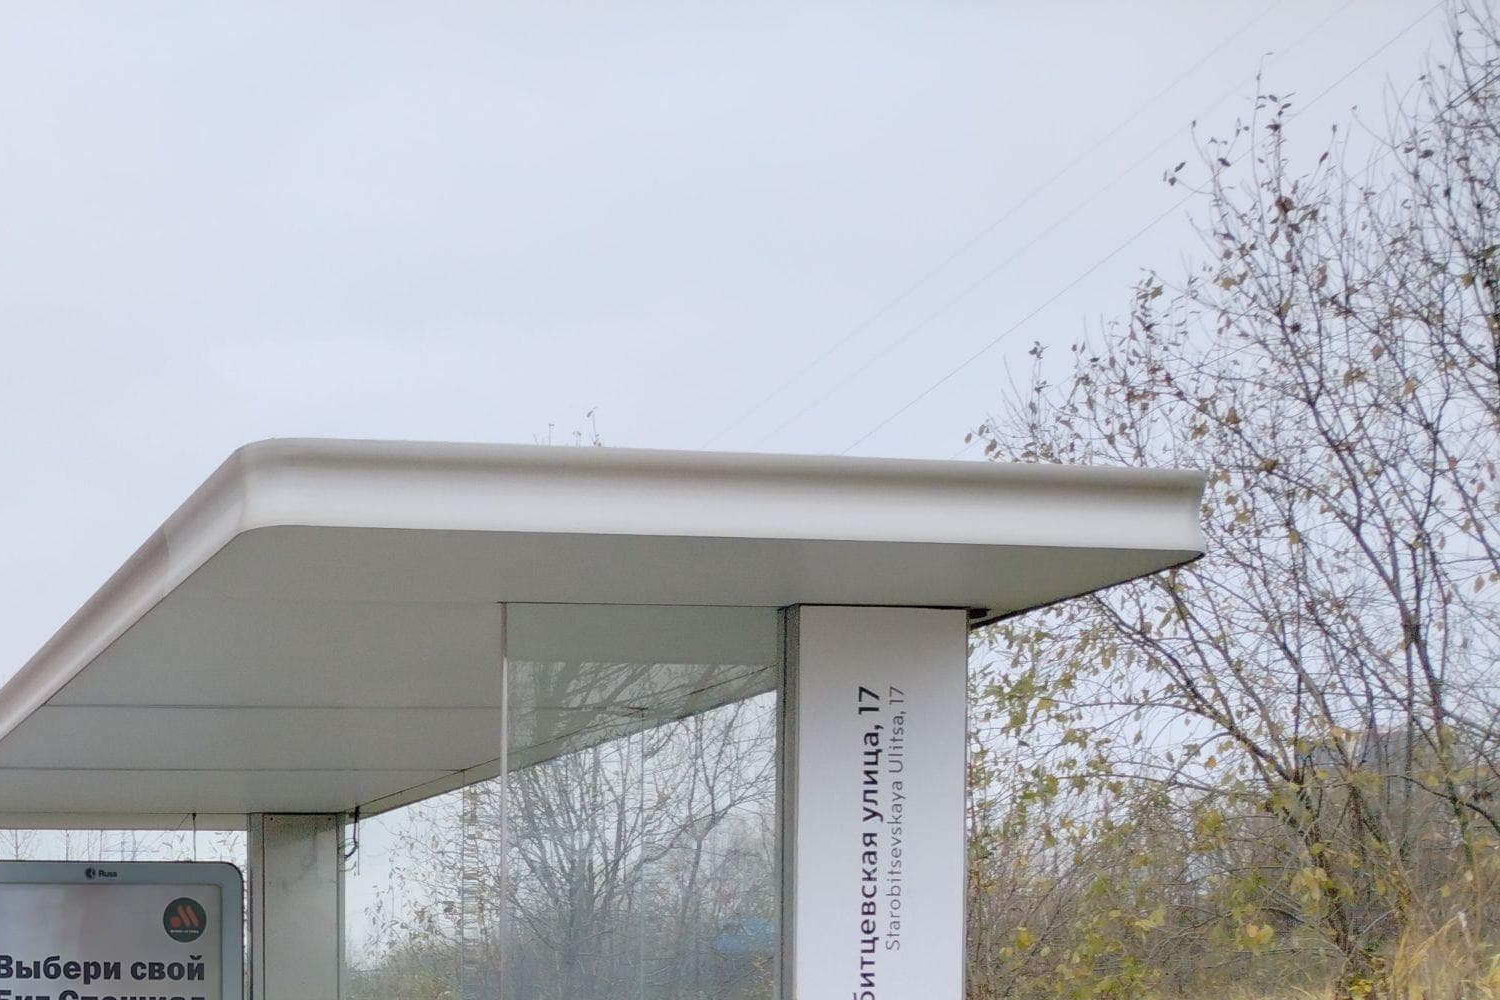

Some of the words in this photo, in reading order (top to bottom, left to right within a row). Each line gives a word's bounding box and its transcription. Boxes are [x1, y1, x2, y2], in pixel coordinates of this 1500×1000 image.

[858, 686, 880, 715] 17
[889, 686, 905, 705] 17
[887, 711, 907, 774] Ulitsa,
[862, 724, 884, 823] улица,
[98, 869, 118, 878] Russ
[885, 780, 906, 951] Starobitsevskaya
[130, 954, 205, 981] свой
